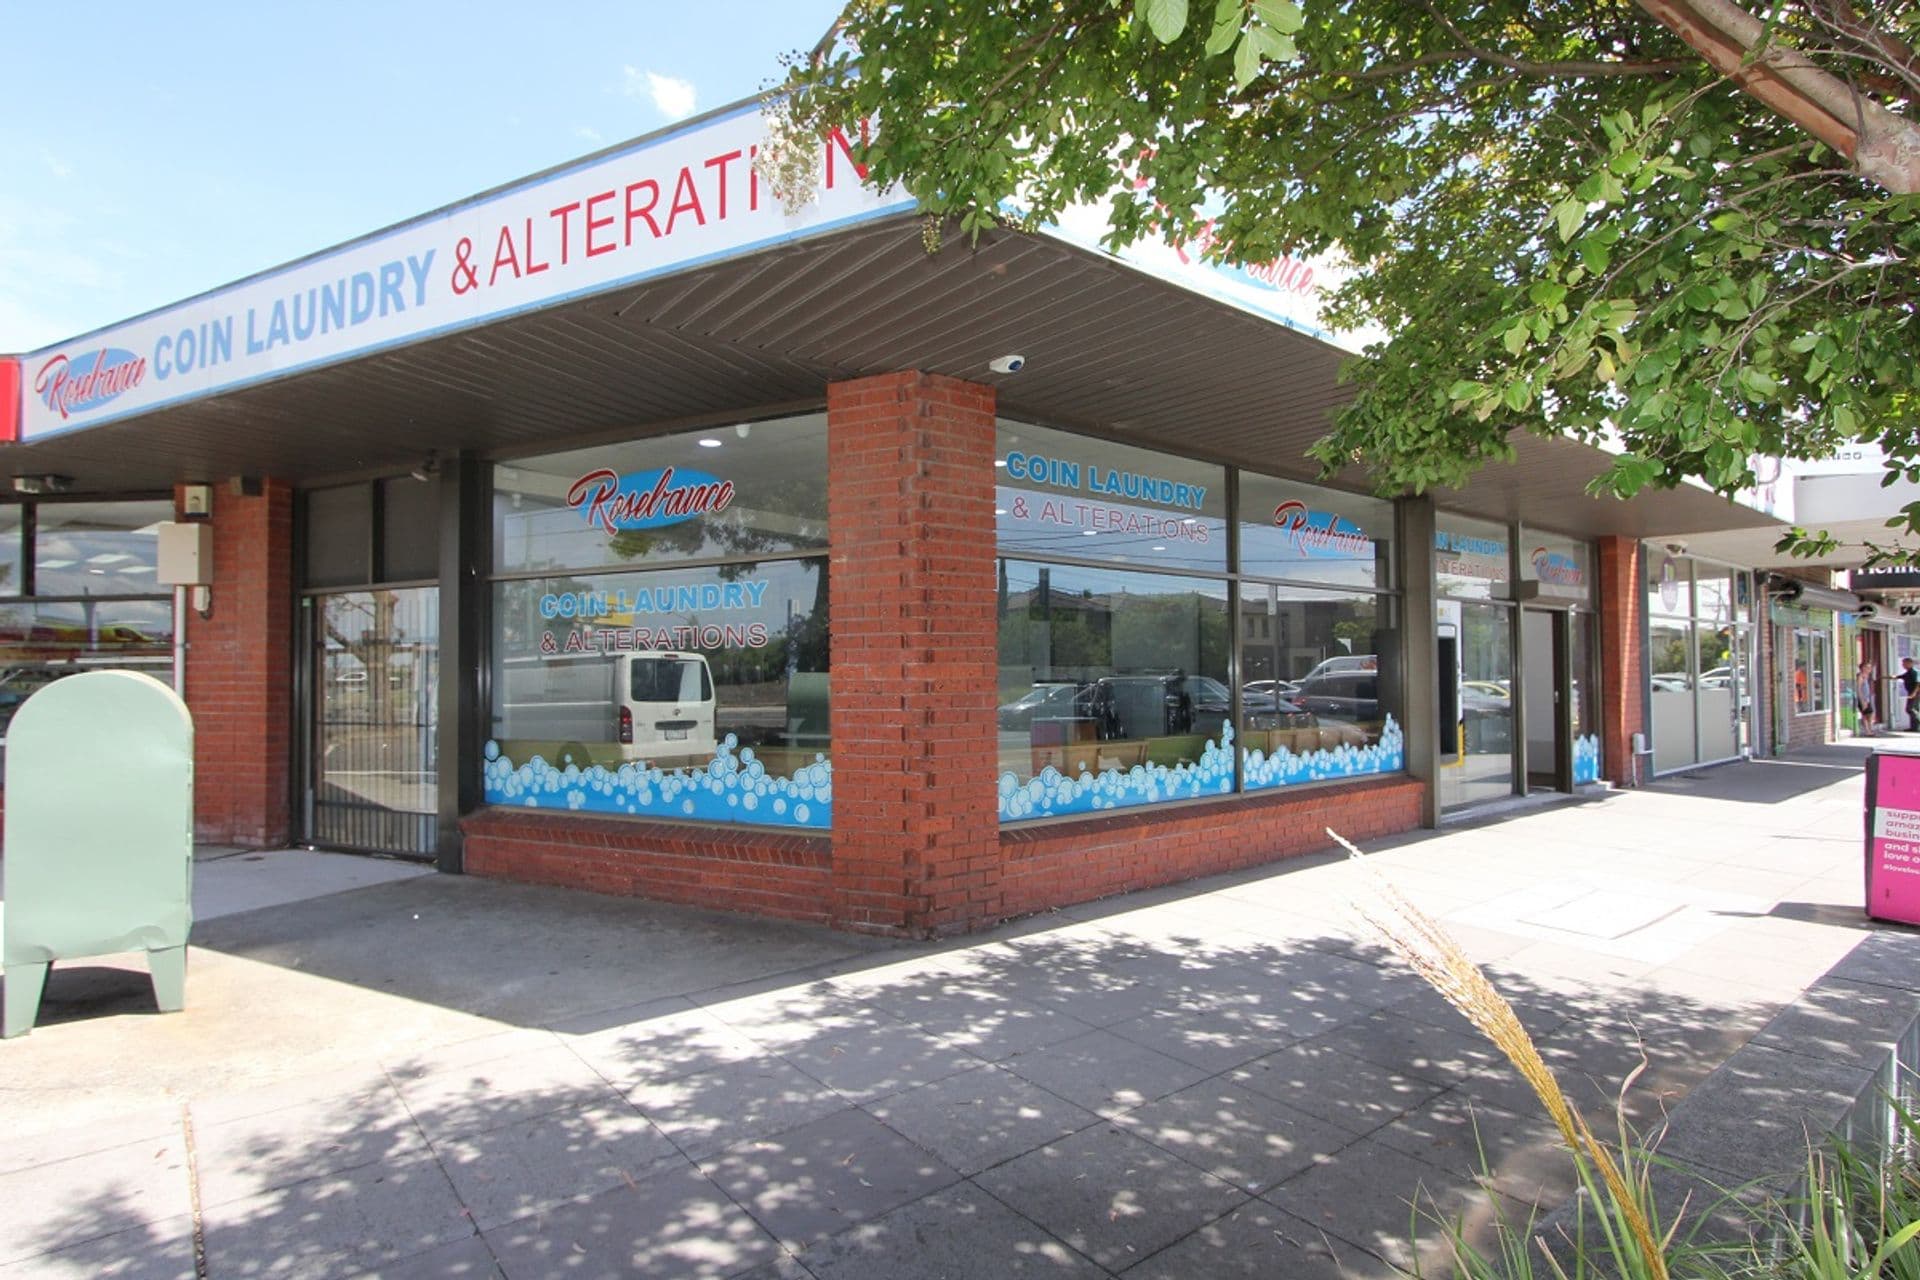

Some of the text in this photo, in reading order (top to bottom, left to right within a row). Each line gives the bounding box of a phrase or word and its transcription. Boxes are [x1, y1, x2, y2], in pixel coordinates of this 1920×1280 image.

[153, 114, 869, 382] COIN LAUNDRY & ALTERATIN
[1005, 451, 1208, 510] COIN LAUNDRY
[1011, 496, 1210, 545] & ALTERATIONS
[539, 580, 769, 620] COIN LAUNDRY
[539, 623, 769, 655] & ALTERATIONS
[1886, 811, 1920, 821] supp
[1883, 850, 1910, 862] love
[1884, 843, 1910, 853] and
